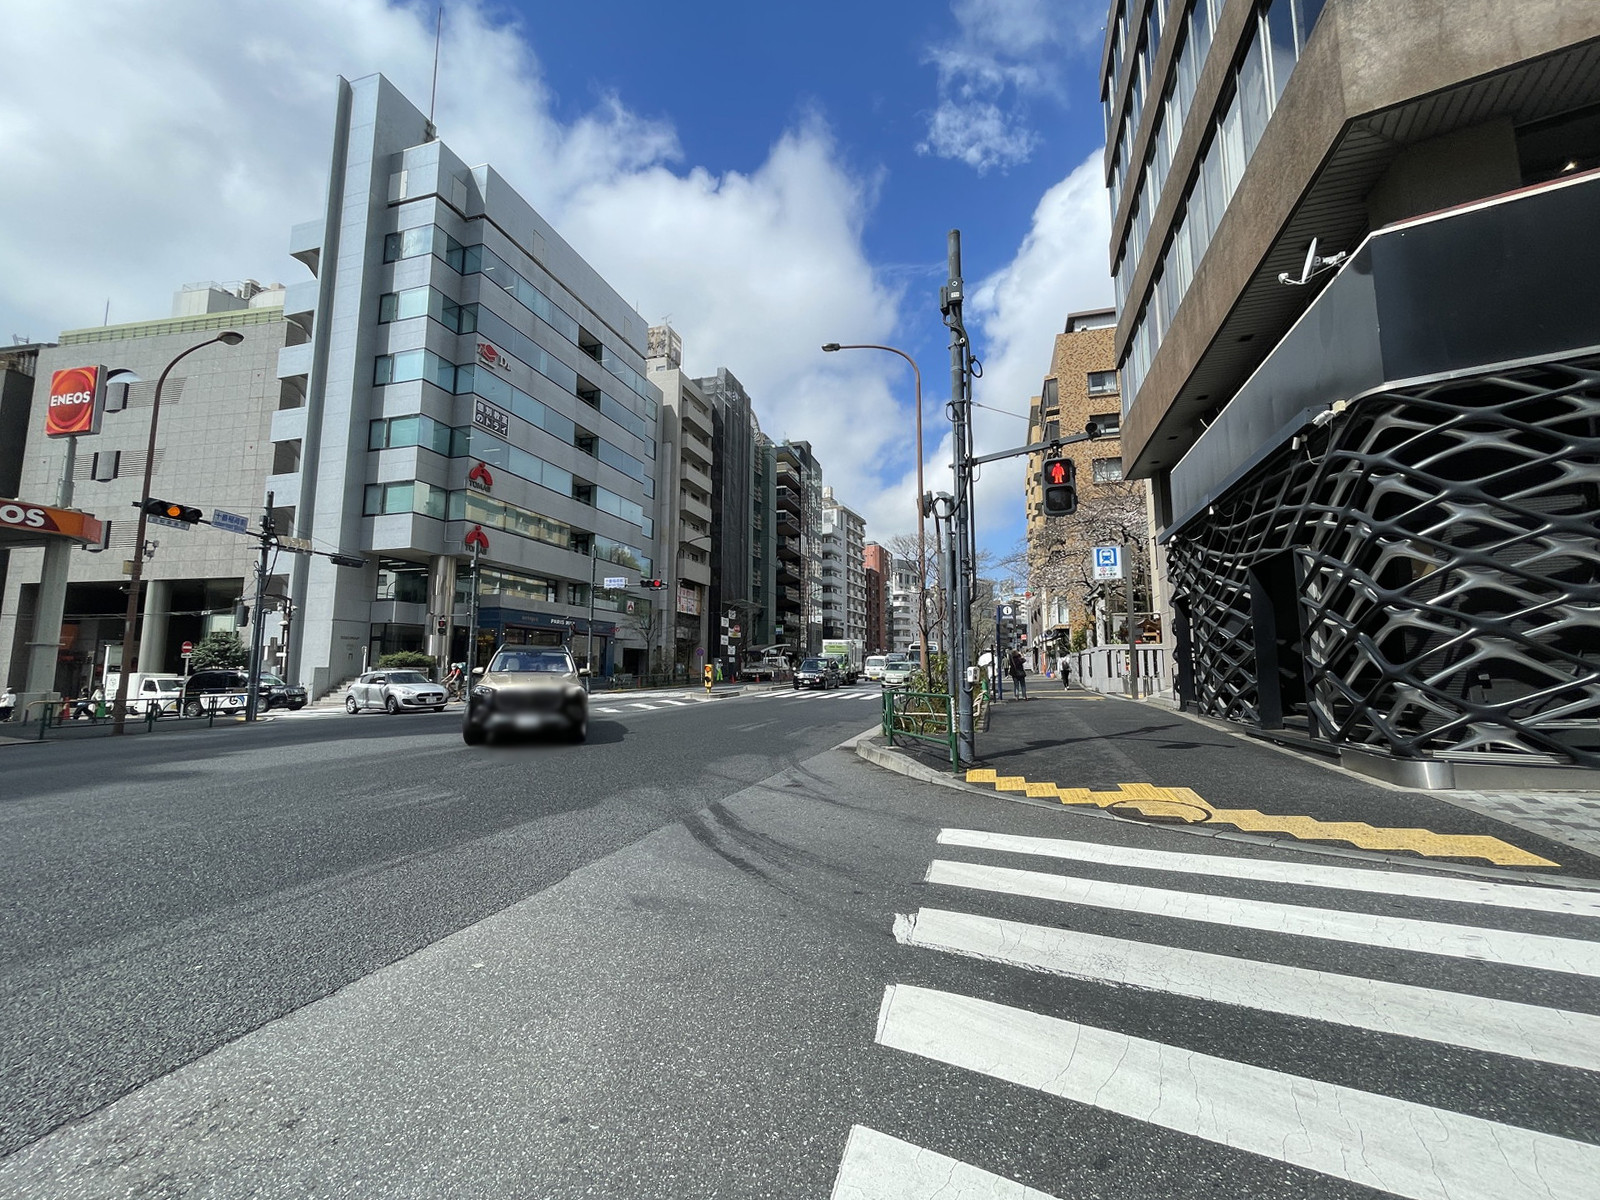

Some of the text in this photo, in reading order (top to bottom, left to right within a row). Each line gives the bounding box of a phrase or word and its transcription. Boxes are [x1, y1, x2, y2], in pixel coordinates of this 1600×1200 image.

[50, 390, 91, 407] ENEOS
[476, 413, 507, 434] のトライ
